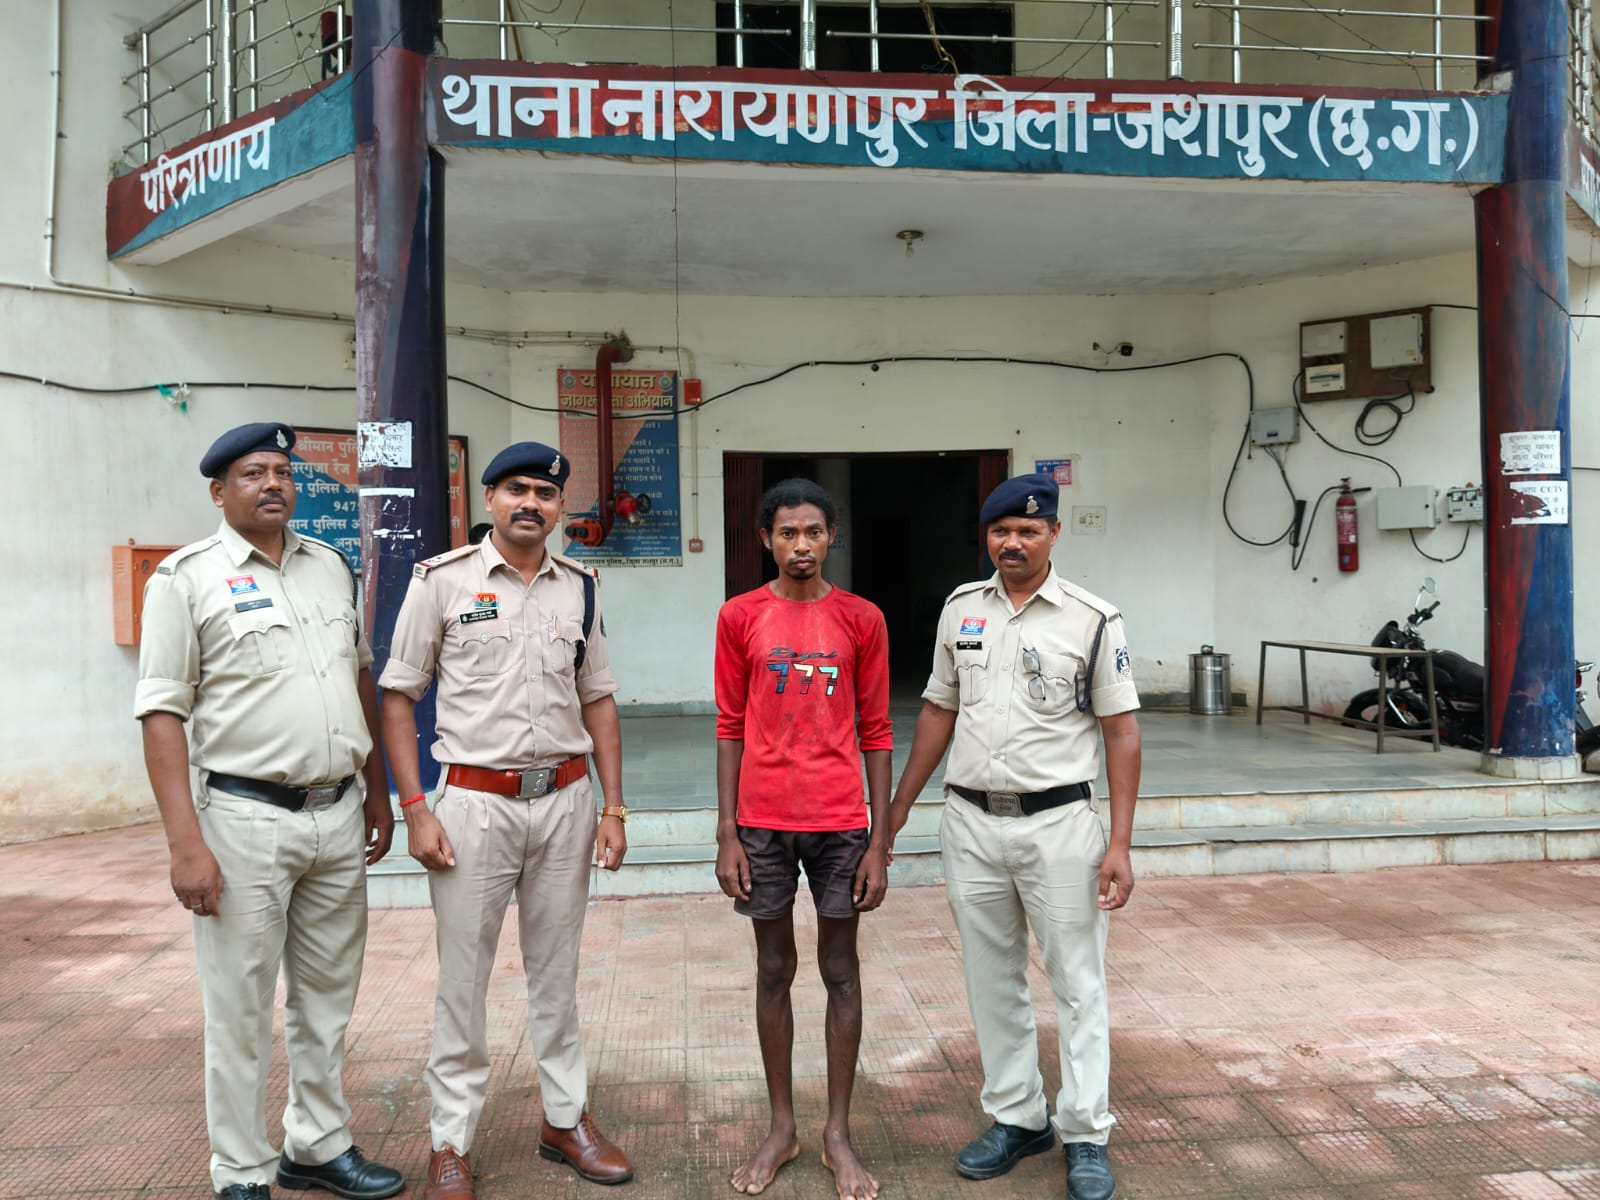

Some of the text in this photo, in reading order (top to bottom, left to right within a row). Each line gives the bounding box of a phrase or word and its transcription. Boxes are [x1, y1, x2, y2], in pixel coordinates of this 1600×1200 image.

[441, 73, 1479, 178] थाना नारायणपुर जिला-जशपुर (छ.ग.)
[626, 391, 673, 408] अभियान
[307, 480, 340, 498] पुलिस
[333, 501, 361, 512] 947
[313, 515, 347, 535] पुलिस
[766, 664, 839, 697] 777
